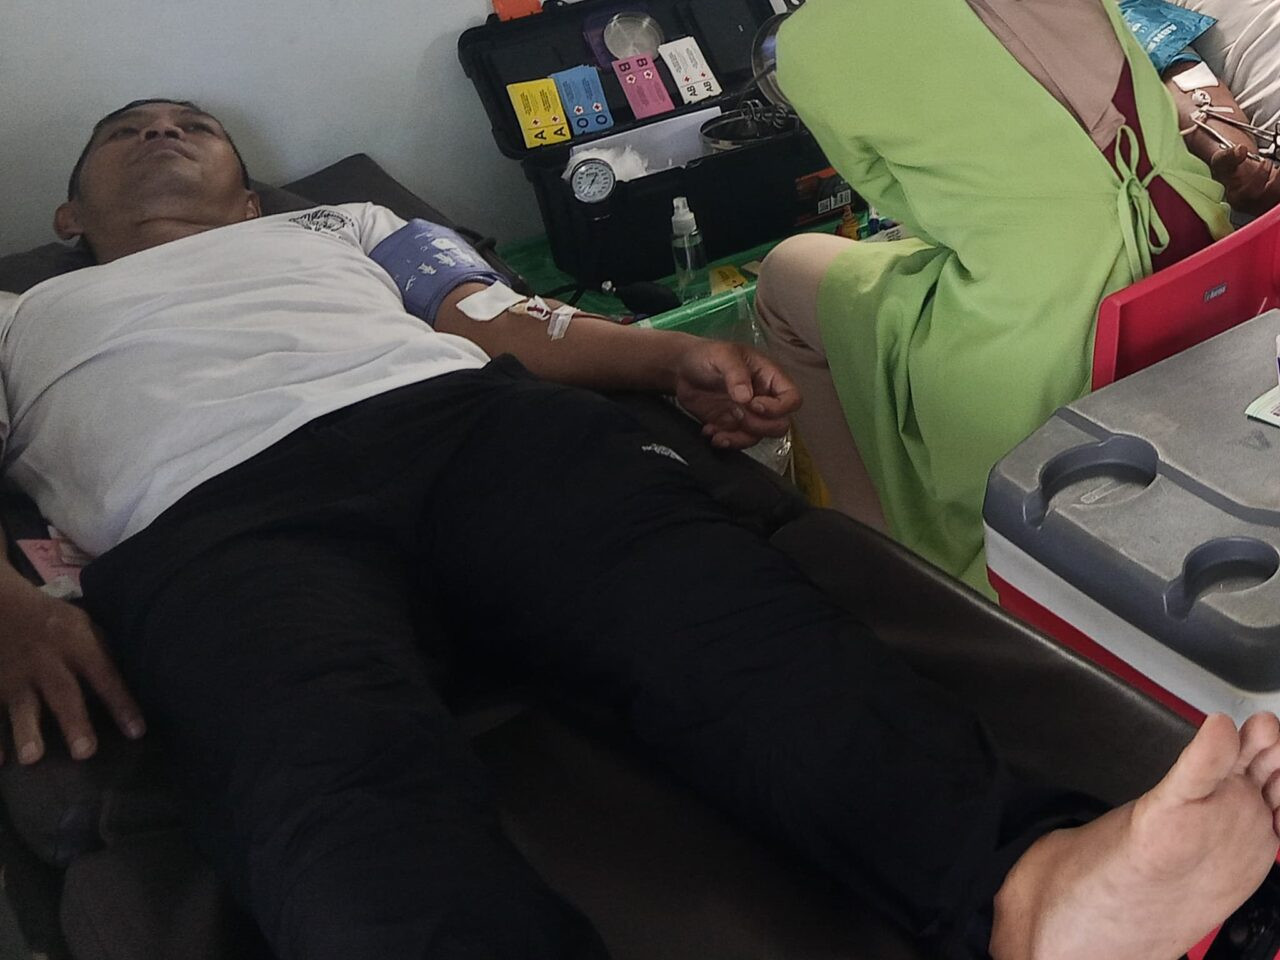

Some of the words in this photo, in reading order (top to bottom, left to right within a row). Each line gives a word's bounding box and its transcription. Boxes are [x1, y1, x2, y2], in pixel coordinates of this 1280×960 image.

[618, 62, 631, 72] B
[636, 58, 648, 67] B
[687, 85, 698, 97] AB
[703, 81, 713, 92] AB
[534, 130, 547, 140] A
[553, 126, 567, 137] A
